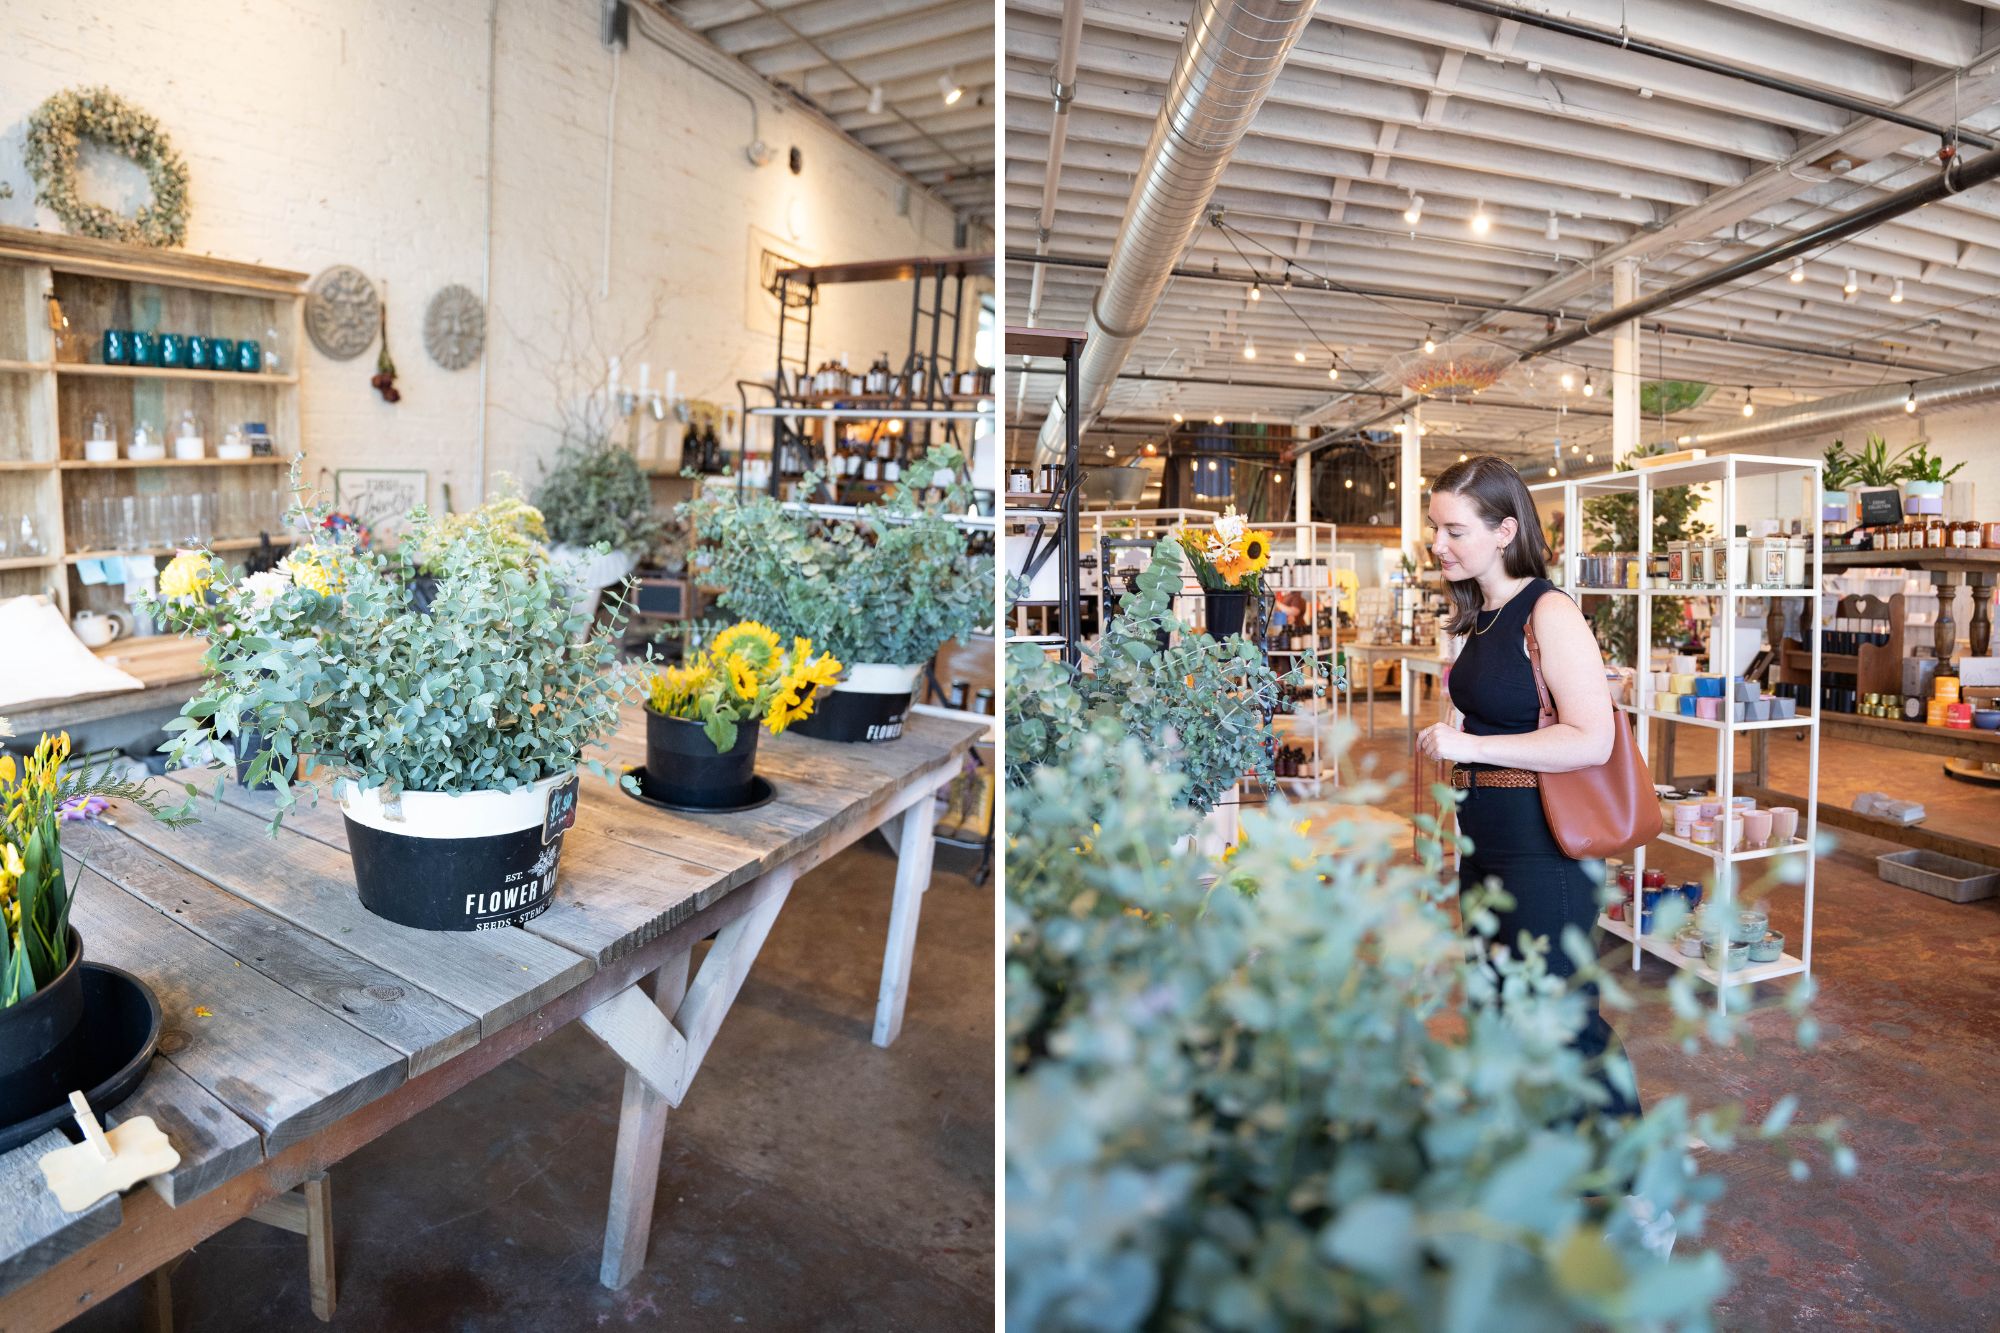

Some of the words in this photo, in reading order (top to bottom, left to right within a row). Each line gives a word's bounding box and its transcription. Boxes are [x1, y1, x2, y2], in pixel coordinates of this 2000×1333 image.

[505, 871, 523, 883] EST.
[465, 880, 538, 915] FLOWER
[475, 918, 512, 932] SEEDS
[519, 903, 545, 923] STEMS
